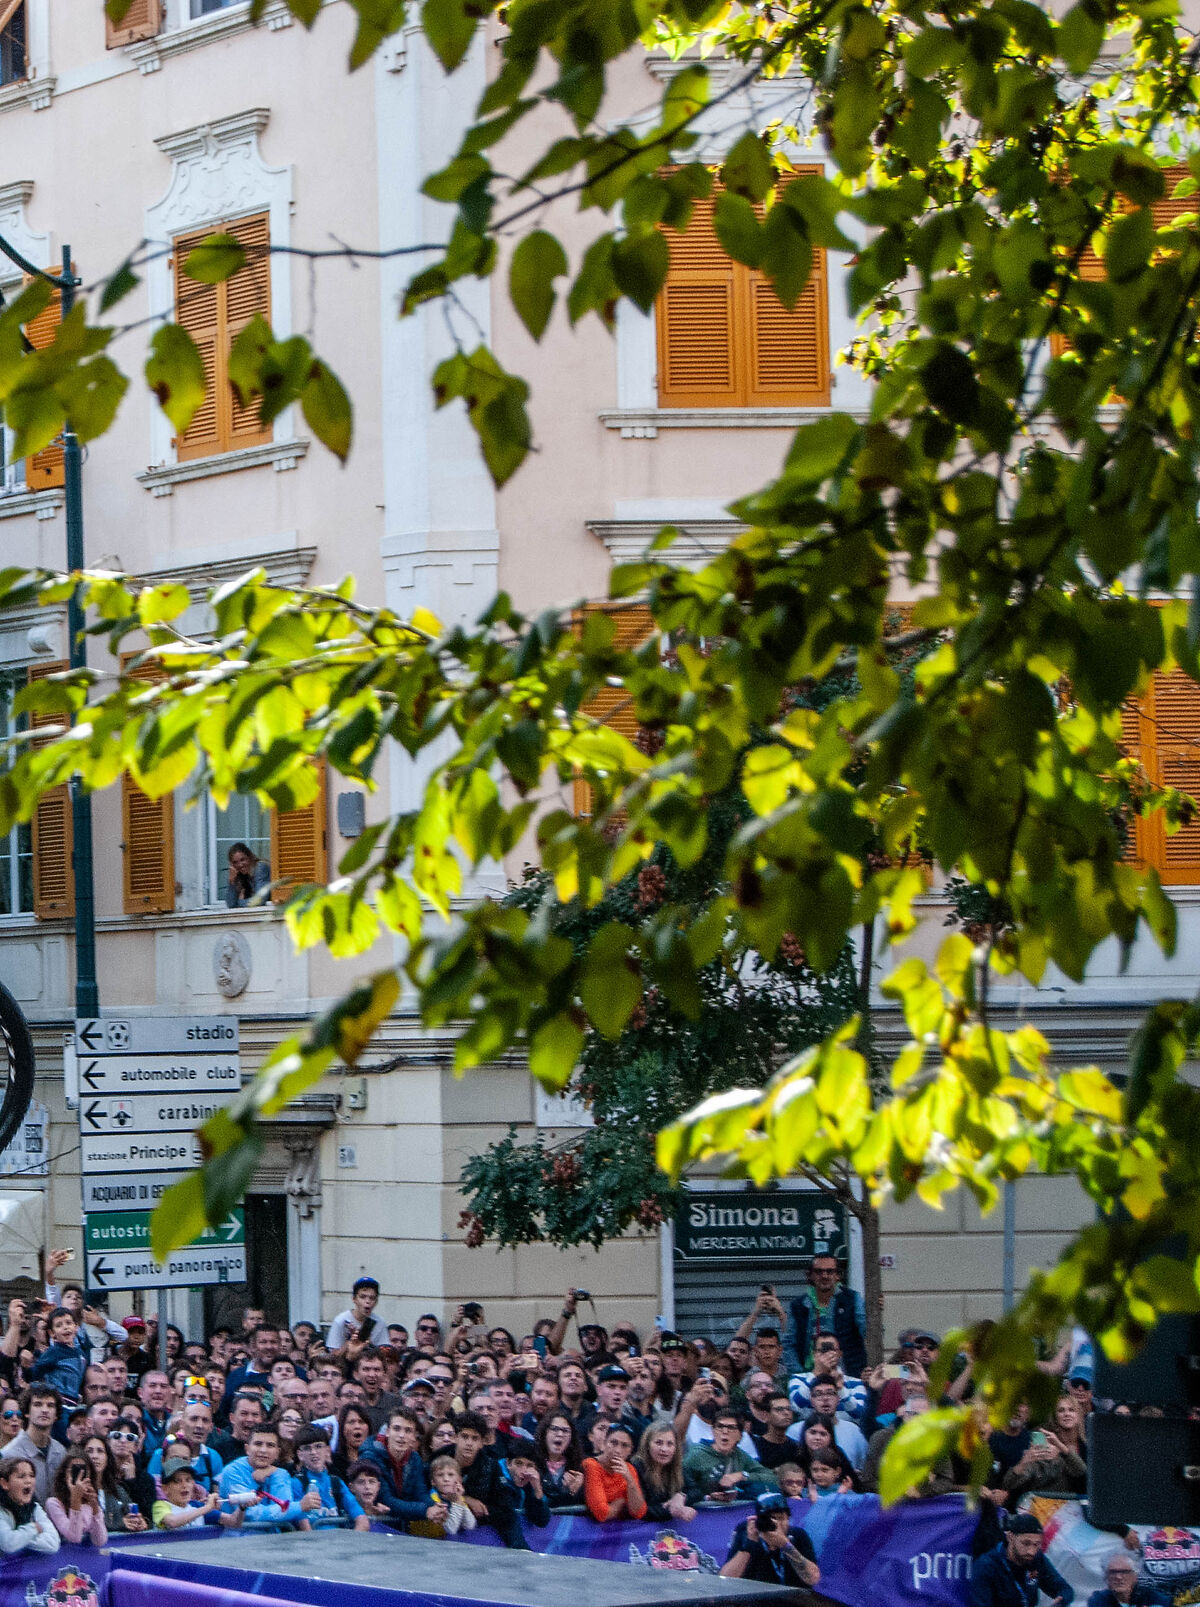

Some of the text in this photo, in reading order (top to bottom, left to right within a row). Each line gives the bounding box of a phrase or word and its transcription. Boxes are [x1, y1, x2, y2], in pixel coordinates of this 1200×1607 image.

[186, 1025, 235, 1040] stadio
[120, 1066, 237, 1081] automobile club
[158, 1104, 225, 1120] carabini
[87, 1145, 187, 1161] stazione Principe
[91, 1185, 137, 1203] ACQUARIO
[138, 1185, 149, 1200] DI
[689, 1202, 800, 1227] Simona
[91, 1225, 153, 1239] autostr
[689, 1235, 806, 1250] MERCERIA INTIMO
[124, 1257, 243, 1277] punto panoramico
